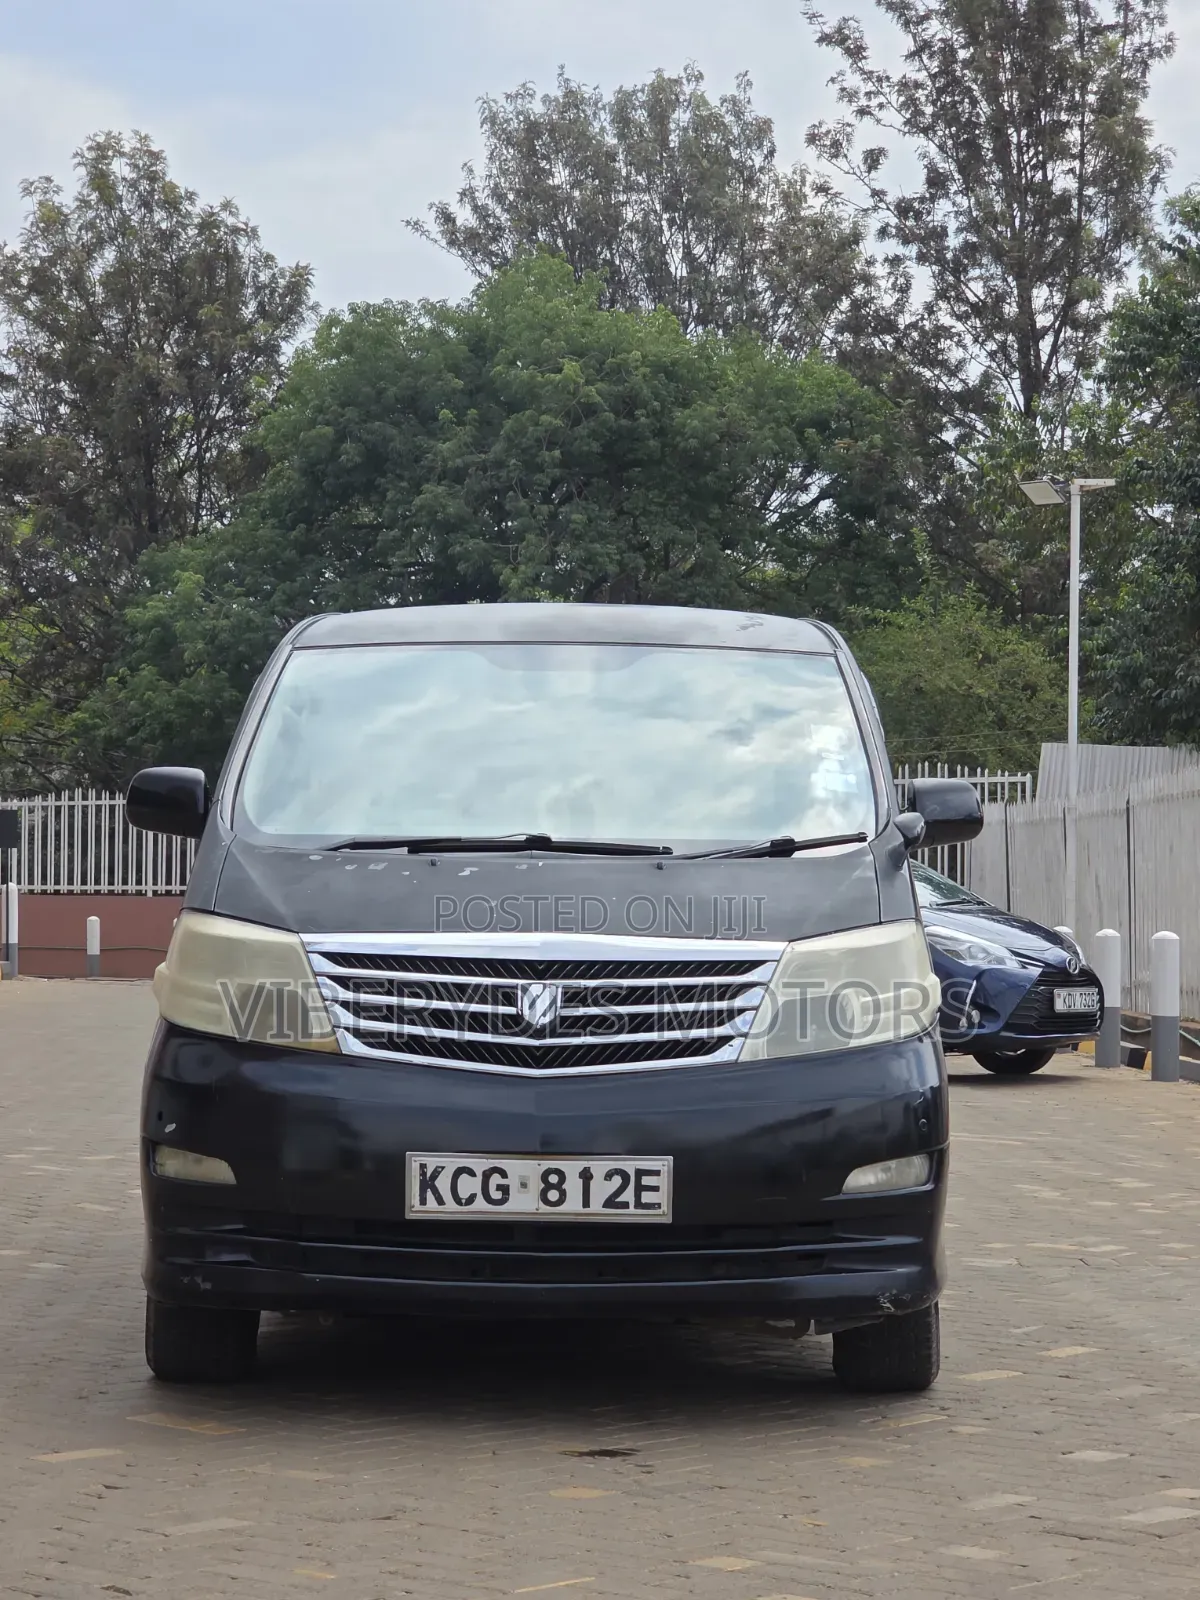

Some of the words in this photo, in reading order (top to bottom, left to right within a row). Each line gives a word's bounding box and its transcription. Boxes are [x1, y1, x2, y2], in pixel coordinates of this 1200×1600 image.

[1063, 993, 1077, 1008] KDV
[418, 1162, 511, 1207] KCG
[539, 1166, 662, 1210] 812E
